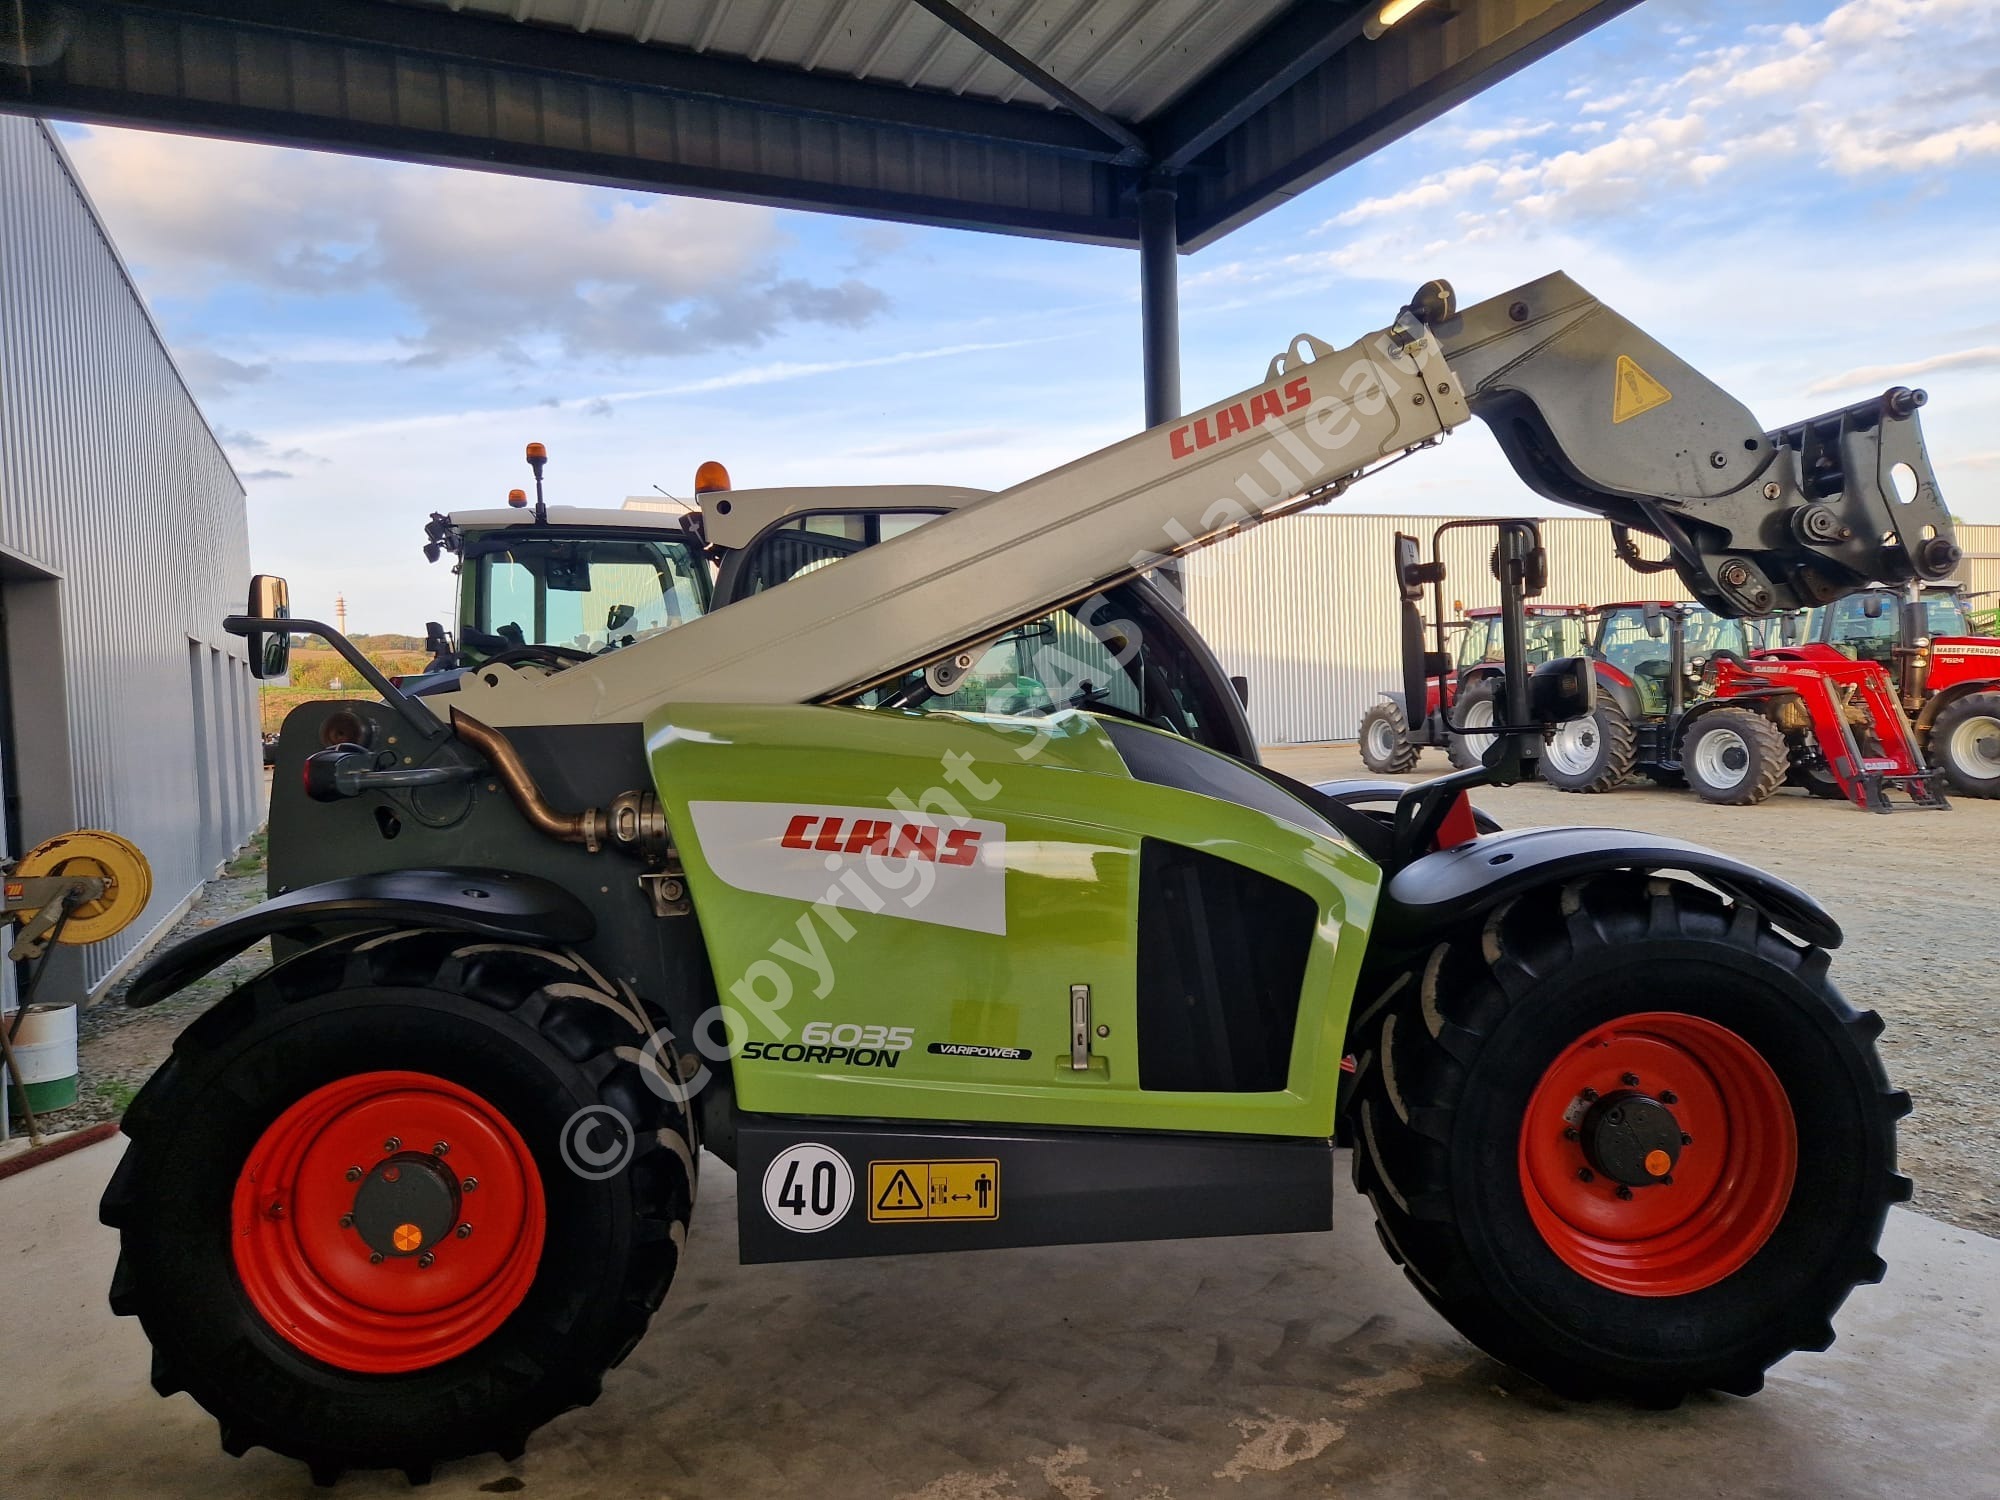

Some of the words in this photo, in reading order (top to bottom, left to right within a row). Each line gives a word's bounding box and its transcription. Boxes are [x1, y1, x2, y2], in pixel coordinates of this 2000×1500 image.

[1169, 376, 1312, 460] CLAAS
[1966, 647, 2000, 655] FERGUSO
[781, 815, 983, 866] CLAAS
[741, 1041, 901, 1069] SCORPION
[939, 1045, 1021, 1060] VARIPOWER
[801, 1021, 915, 1051] 6035
[778, 1160, 837, 1216] 40
